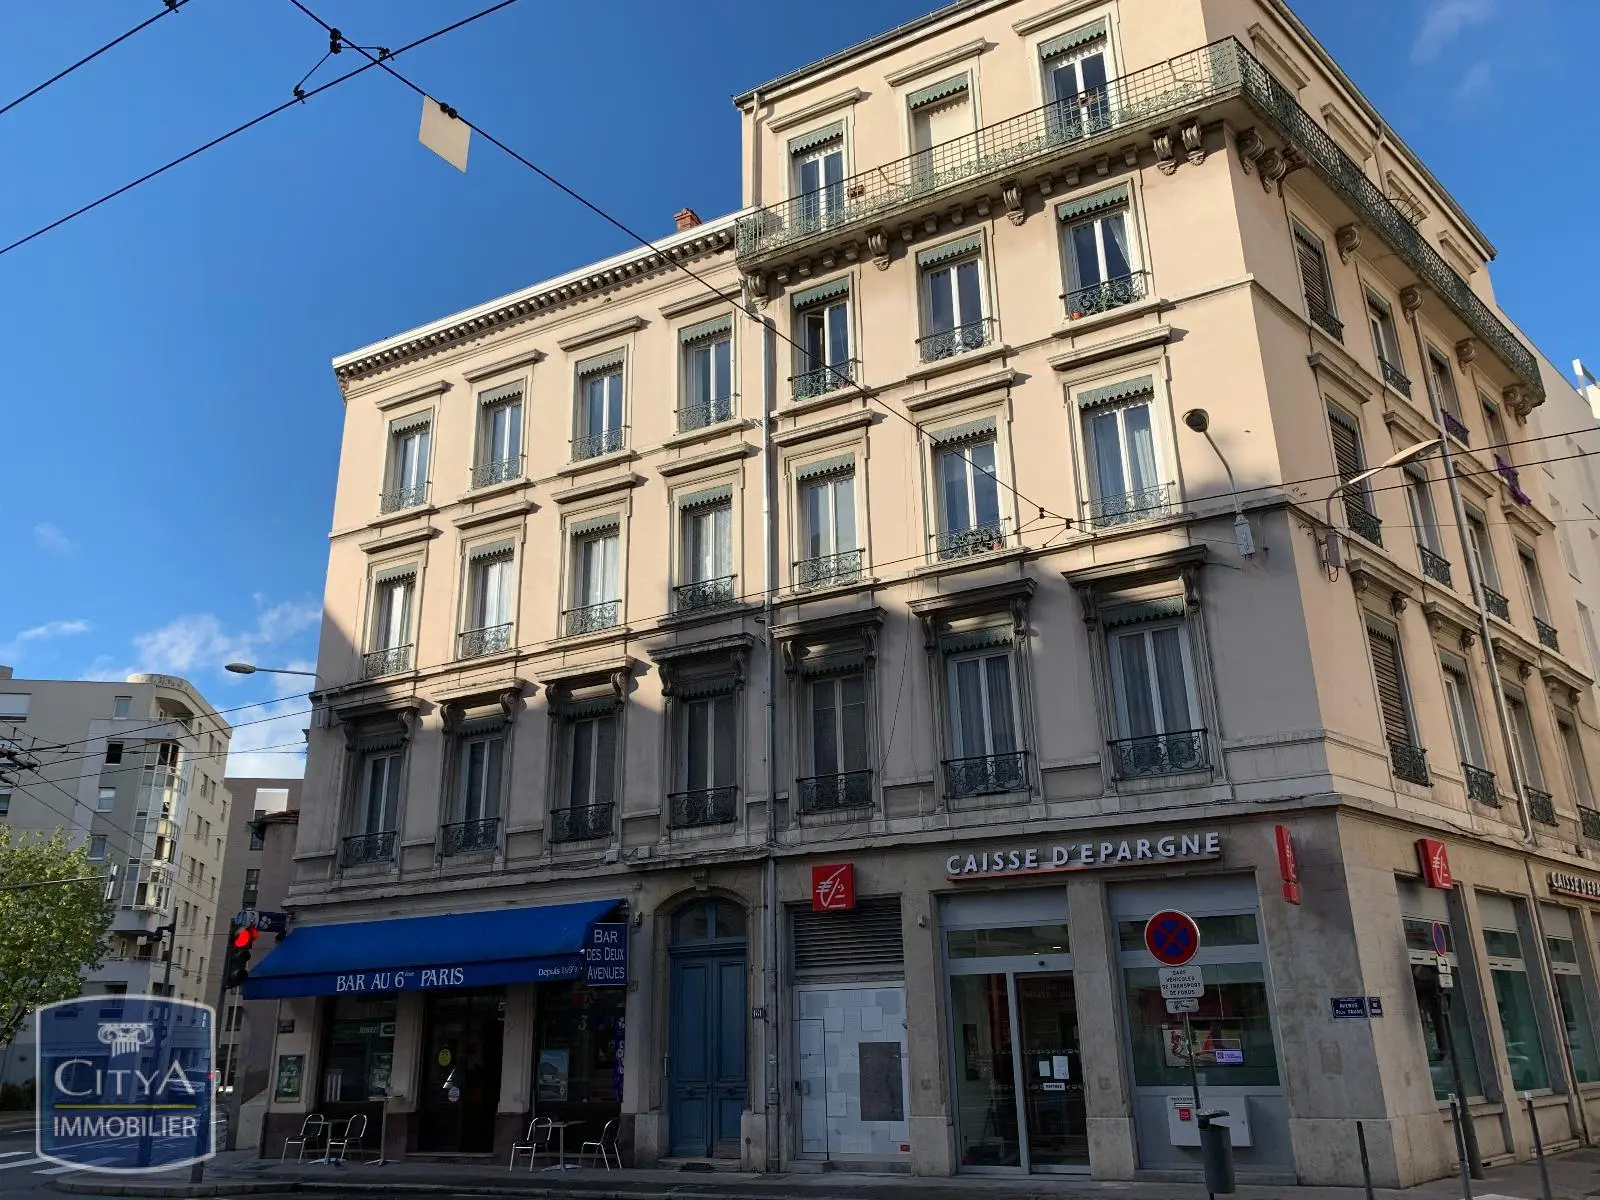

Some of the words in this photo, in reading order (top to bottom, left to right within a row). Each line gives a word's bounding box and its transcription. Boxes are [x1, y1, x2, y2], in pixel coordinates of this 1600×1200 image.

[946, 848, 1038, 875] CAISSE
[1052, 831, 1221, 866] D'EPARGNE
[1551, 871, 1580, 892] CAISSE
[594, 929, 618, 943] BAR
[586, 948, 602, 961] DES
[604, 947, 625, 961] DEUX
[538, 966, 560, 977] Depuis
[587, 965, 625, 980] AVENUES
[336, 974, 365, 992] BAR
[371, 972, 391, 990] AU
[420, 967, 464, 987] PARIS
